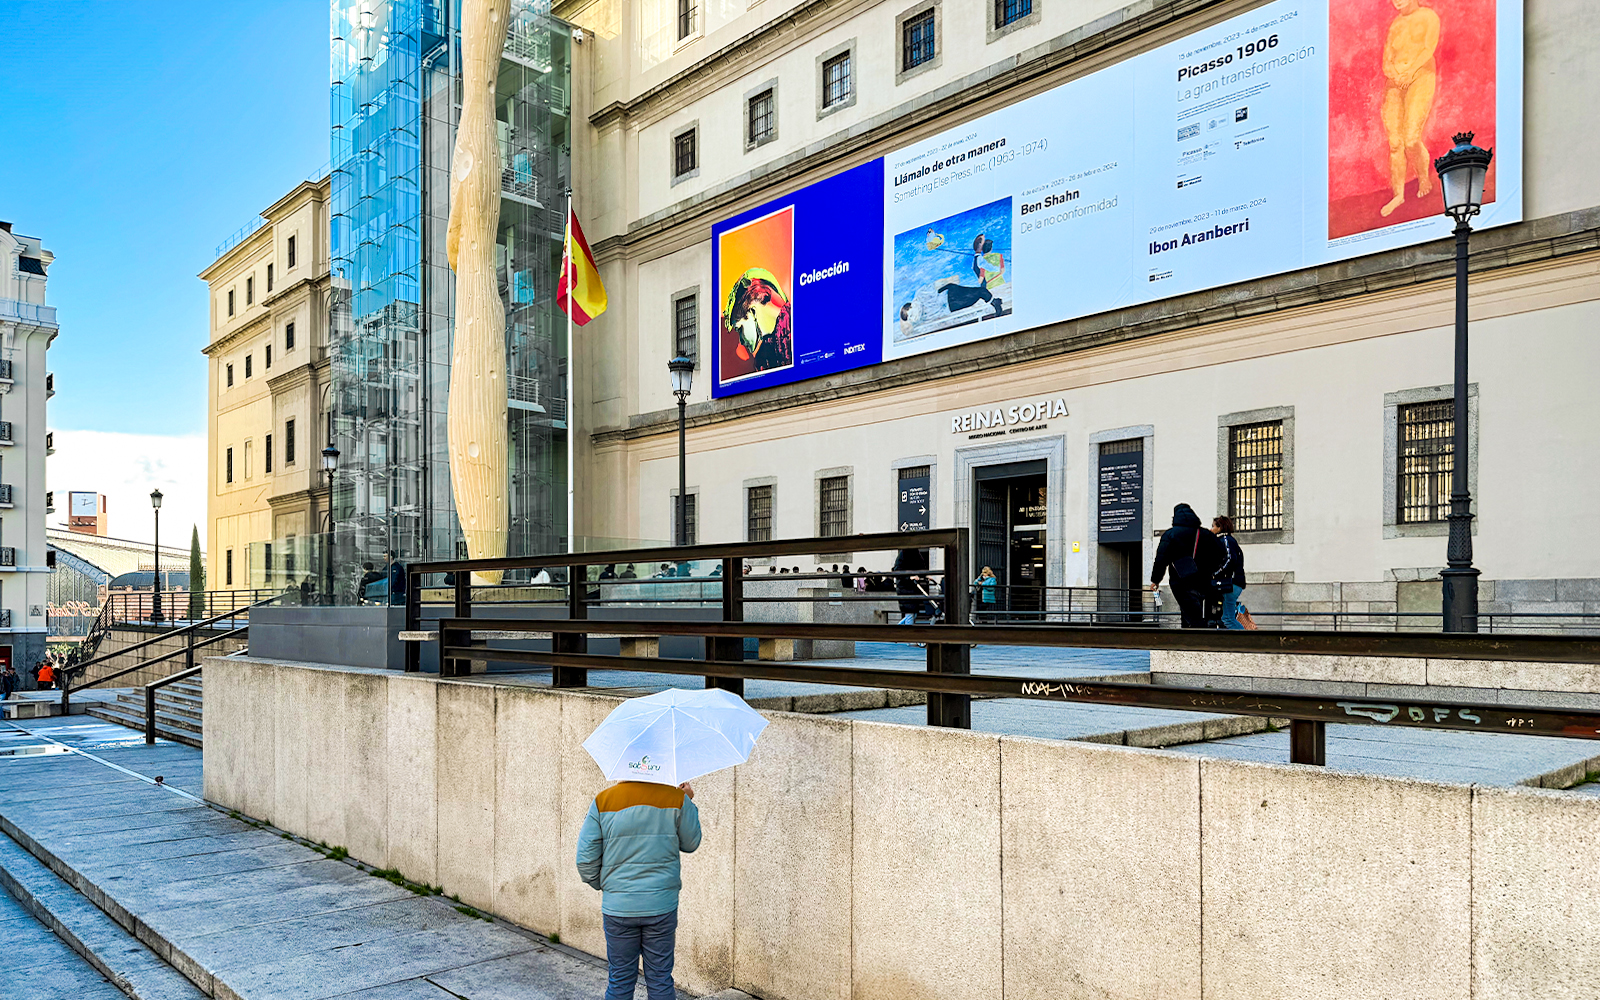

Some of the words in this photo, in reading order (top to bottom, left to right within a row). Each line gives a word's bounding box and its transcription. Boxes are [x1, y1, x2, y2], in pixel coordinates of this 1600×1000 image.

[1223, 32, 1240, 44] 2023
[1251, 25, 1259, 34] de
[1279, 10, 1298, 23] 2024
[1177, 53, 1233, 82] Picasso
[1236, 34, 1279, 60] 1906
[1177, 88, 1191, 102] La
[1193, 79, 1219, 100] gran
[1221, 45, 1315, 86] transformación
[965, 132, 978, 142] 2024
[894, 164, 931, 187] Llámalo
[932, 157, 944, 173] de
[945, 151, 966, 167] otra
[967, 137, 1006, 159] manera
[1102, 161, 1118, 172] 2024
[894, 180, 933, 203] Something
[933, 176, 949, 190] Else
[950, 168, 973, 183] Press,
[973, 163, 987, 176] Inc.
[1020, 221, 1033, 235] De
[1034, 218, 1042, 230] la
[1043, 215, 1056, 227] no
[1056, 195, 1118, 222] conformidad
[1021, 201, 1042, 216] Ben
[1044, 189, 1080, 209] Shahn
[1149, 226, 1157, 234] 29
[1157, 224, 1164, 232] de
[1193, 211, 1210, 223] 2023
[1214, 209, 1221, 217] 11
[1221, 207, 1229, 215] de
[1249, 197, 1267, 208] 2024
[1149, 238, 1178, 255] Ibon
[1181, 217, 1249, 247] Aranberri
[800, 260, 849, 286] Colección
[844, 343, 865, 355] INDITEX
[951, 408, 1006, 434] REINA
[1008, 398, 1069, 426] SOFIA
[983, 430, 1007, 438] NACIONAL
